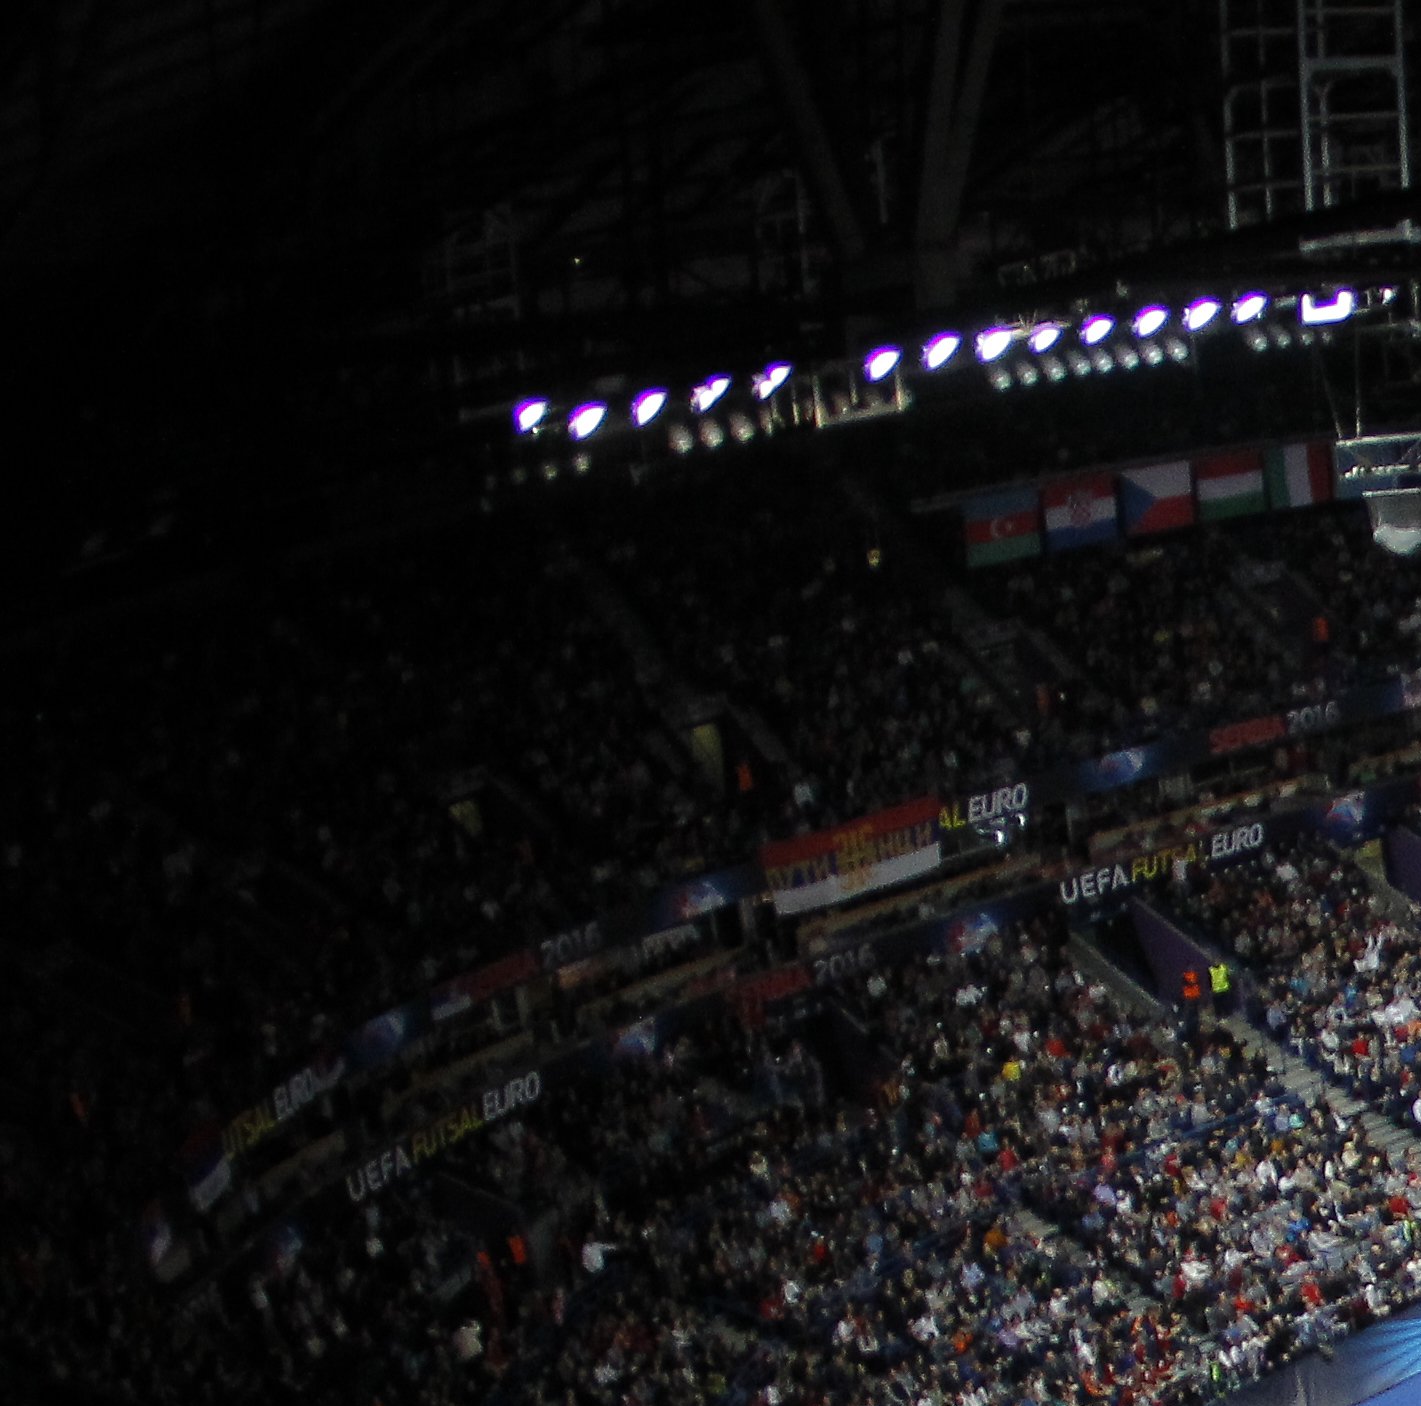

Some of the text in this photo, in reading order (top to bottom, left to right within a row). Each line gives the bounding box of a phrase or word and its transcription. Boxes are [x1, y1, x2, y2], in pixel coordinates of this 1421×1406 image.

[968, 782, 1029, 824] EURO
[1060, 863, 1130, 904] UEFA
[1210, 822, 1265, 859] EURO
[482, 1070, 542, 1121] EURO
